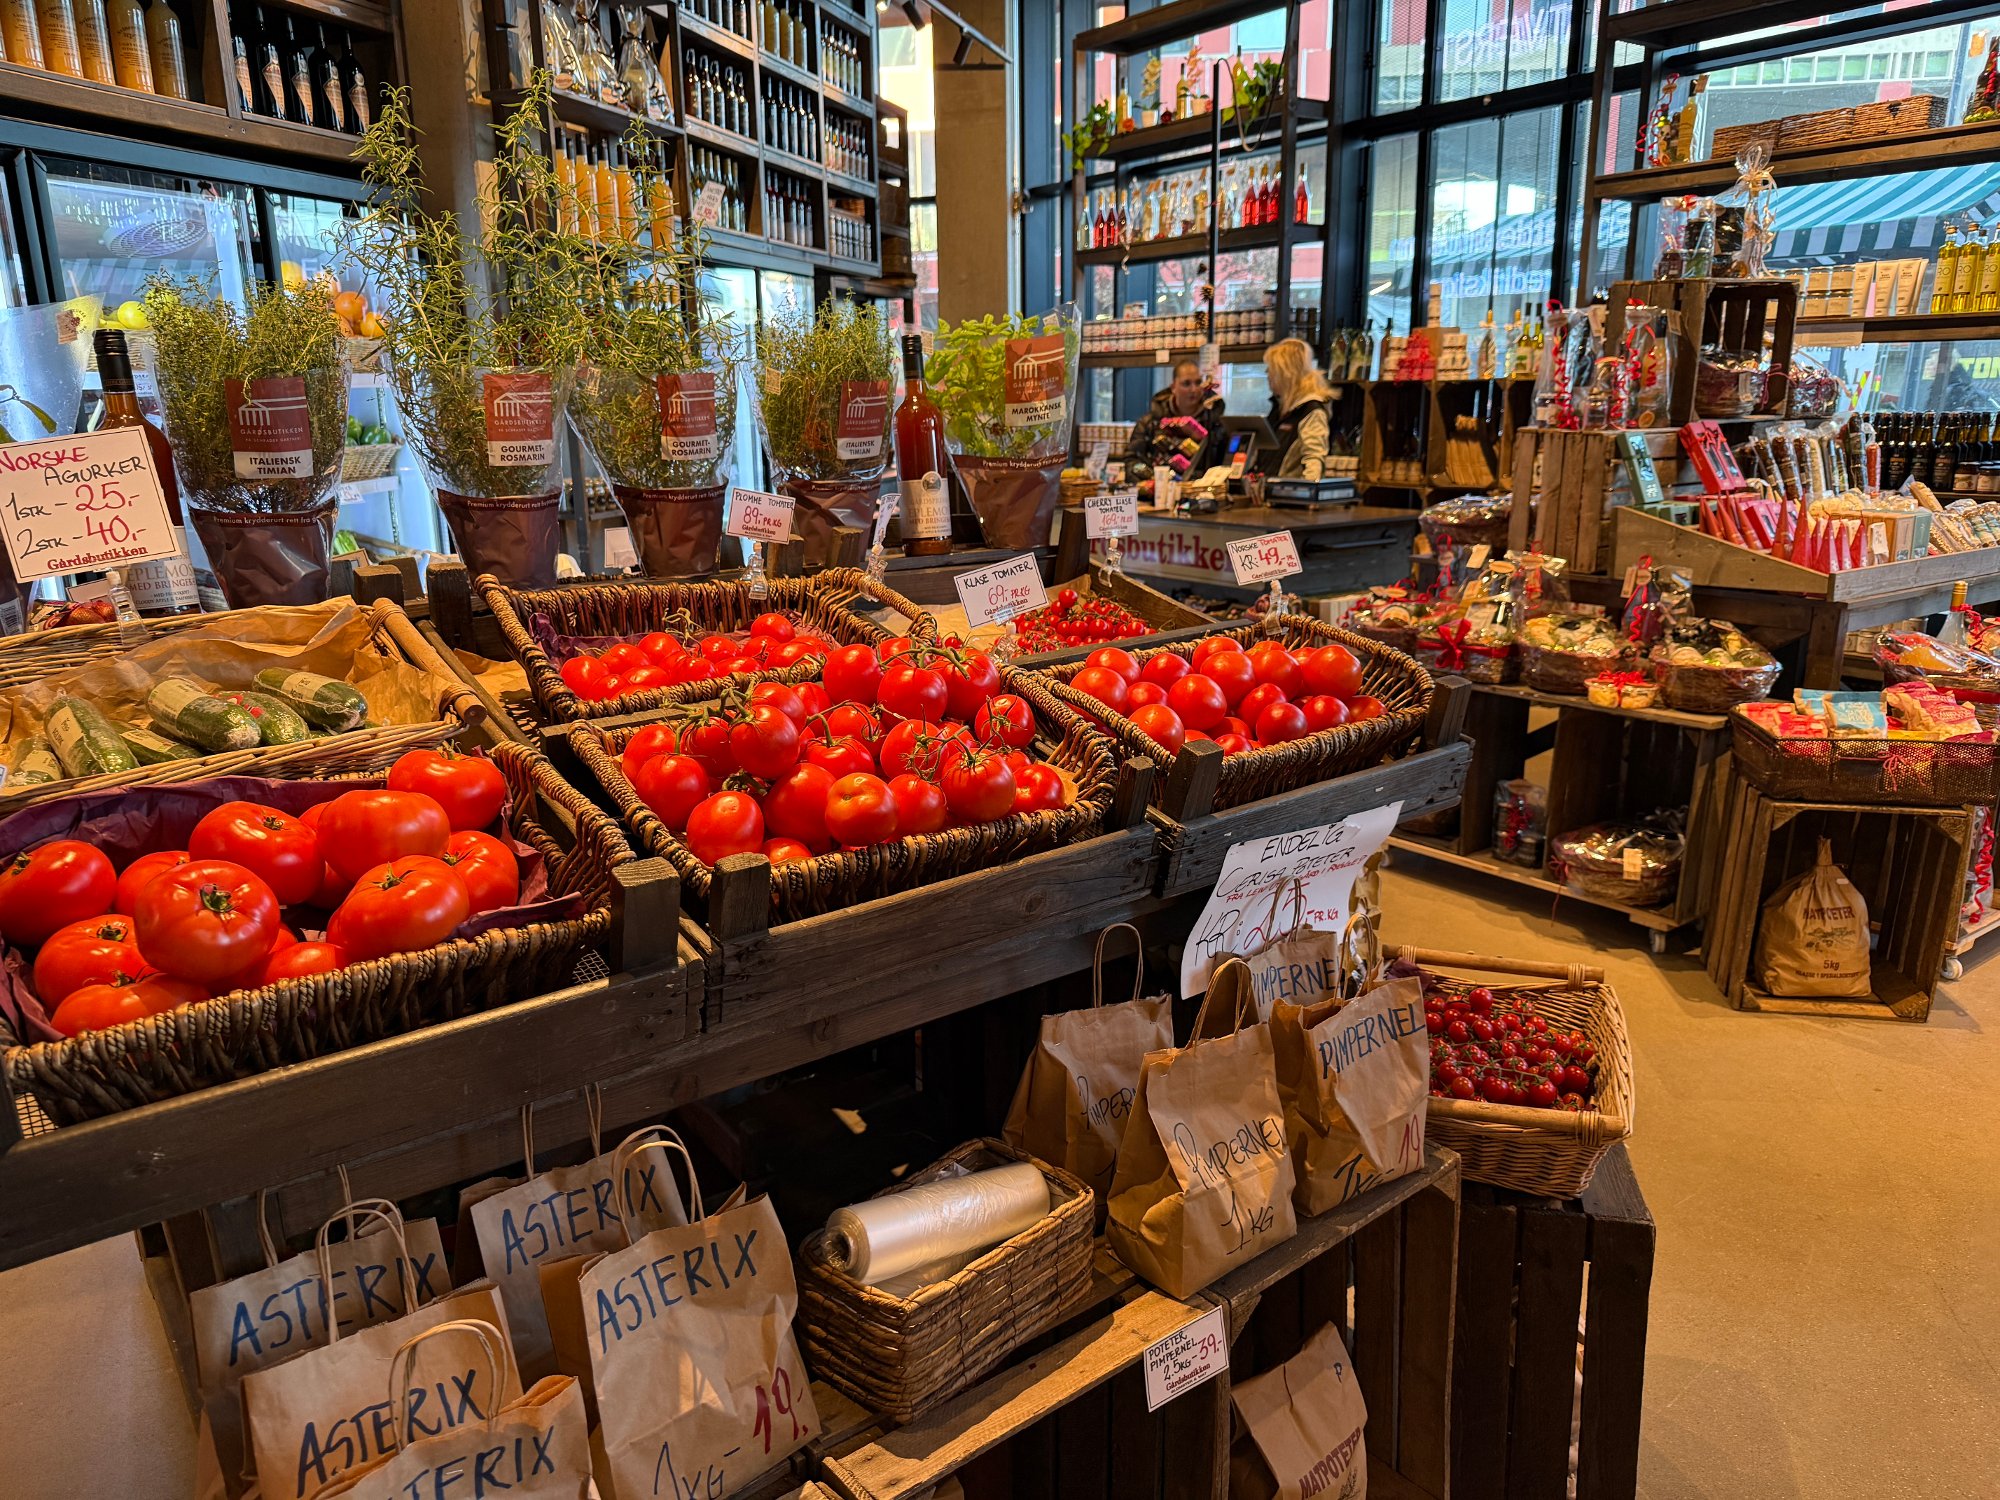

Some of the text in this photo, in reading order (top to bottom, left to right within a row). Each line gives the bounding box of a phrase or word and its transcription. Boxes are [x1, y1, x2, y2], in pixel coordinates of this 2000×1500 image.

[1011, 401, 1062, 415] MAROKKANSK
[1026, 412, 1050, 422] MYNTE
[671, 447, 711, 456] ROSMARIN
[845, 440, 875, 448] ITALIENSK
[249, 456, 302, 465] ITALIENSK
[500, 453, 545, 462] ROSMARIN
[44, 456, 147, 487] AGURKER
[256, 466, 297, 475] TIMIAN
[735, 491, 762, 505] PLOMME
[1087, 498, 1112, 508] CHERRY
[1099, 506, 1125, 514] TOMATER
[47, 545, 149, 571] Gårdsbutikken
[1230, 542, 1259, 554] NORSKE
[963, 561, 1034, 590] KLASE TOMATER
[1260, 825, 1345, 863] ENDELIG
[1318, 1003, 1426, 1079] PIMPERNEL
[502, 1164, 663, 1275] ASTERIX
[595, 1229, 758, 1355] ASTERIX
[229, 1252, 438, 1367] ASTERIX
[1148, 1330, 1188, 1360] POTETER
[1149, 1337, 1199, 1372] PIMPERNEL
[296, 1368, 487, 1499] ASTERIX
